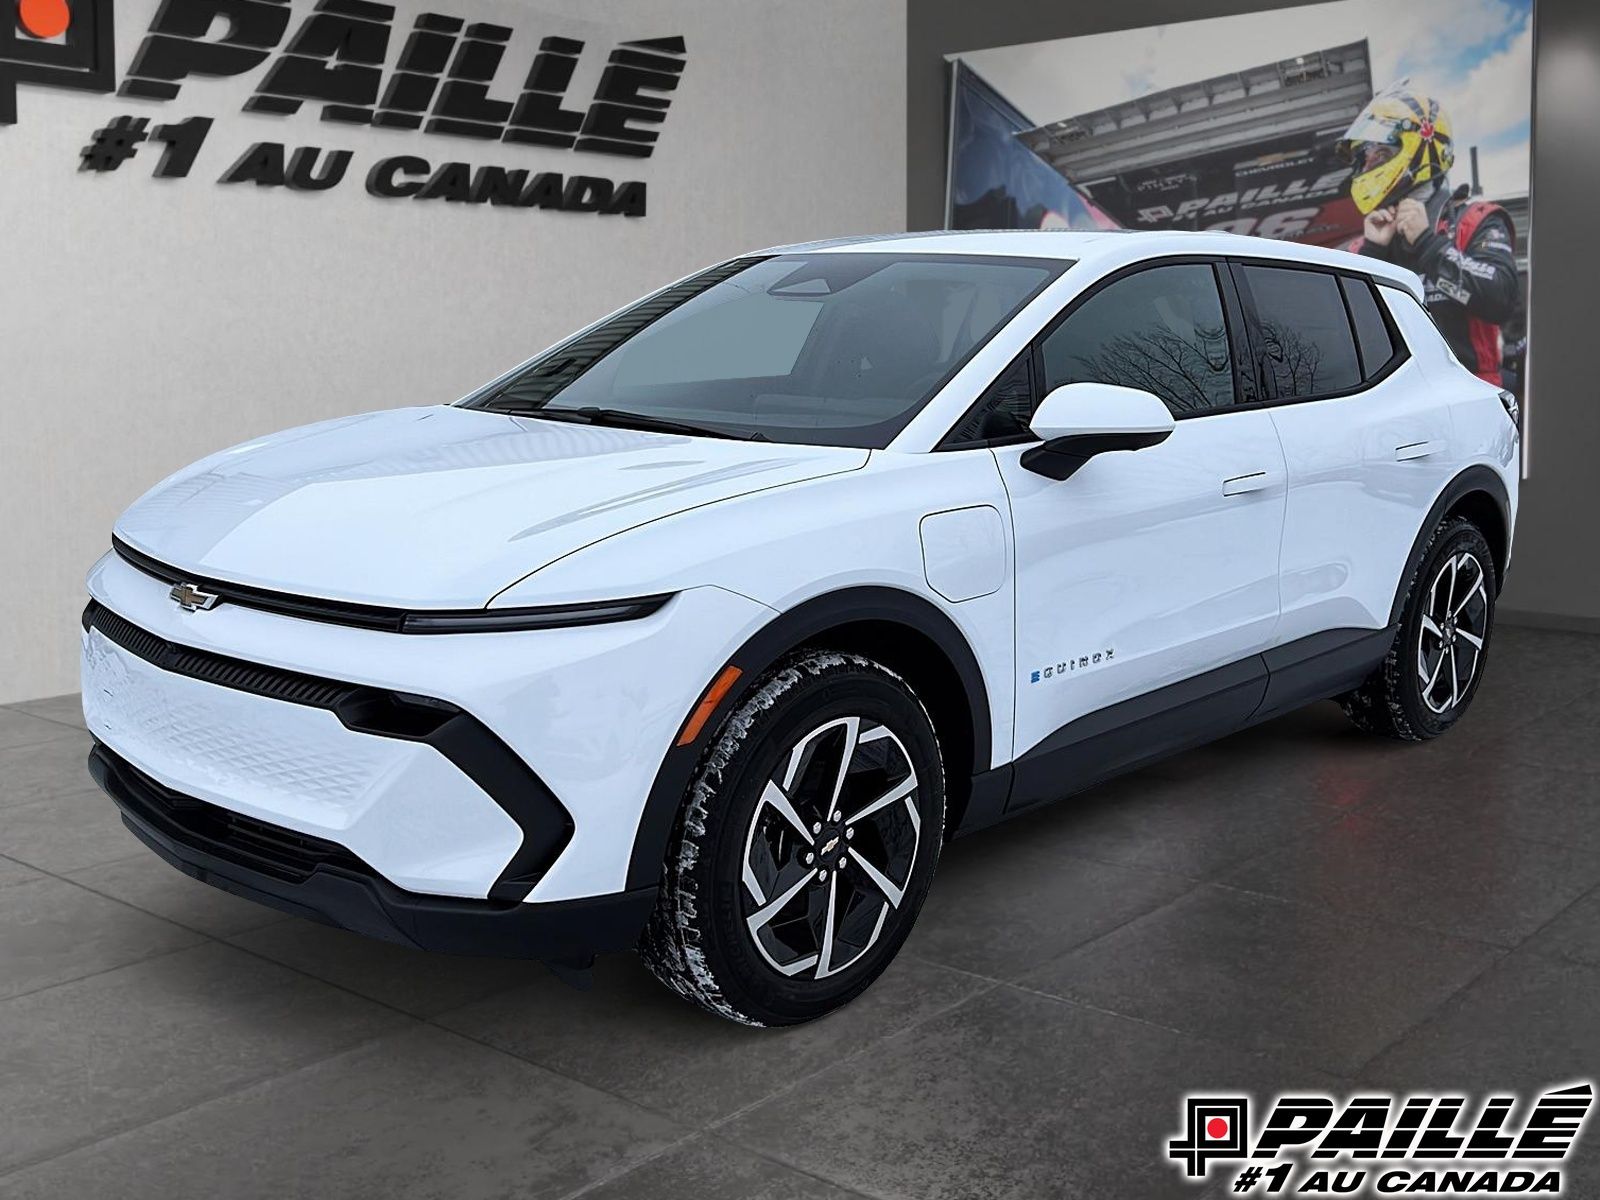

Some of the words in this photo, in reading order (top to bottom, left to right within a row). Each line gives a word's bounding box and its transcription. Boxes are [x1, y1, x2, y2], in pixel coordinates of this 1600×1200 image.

[117, 0, 687, 159] PAILLÉ
[78, 115, 214, 179] #1
[217, 141, 354, 192] AU
[365, 155, 647, 219] CANADA
[1030, 648, 1115, 684] EQUINOX
